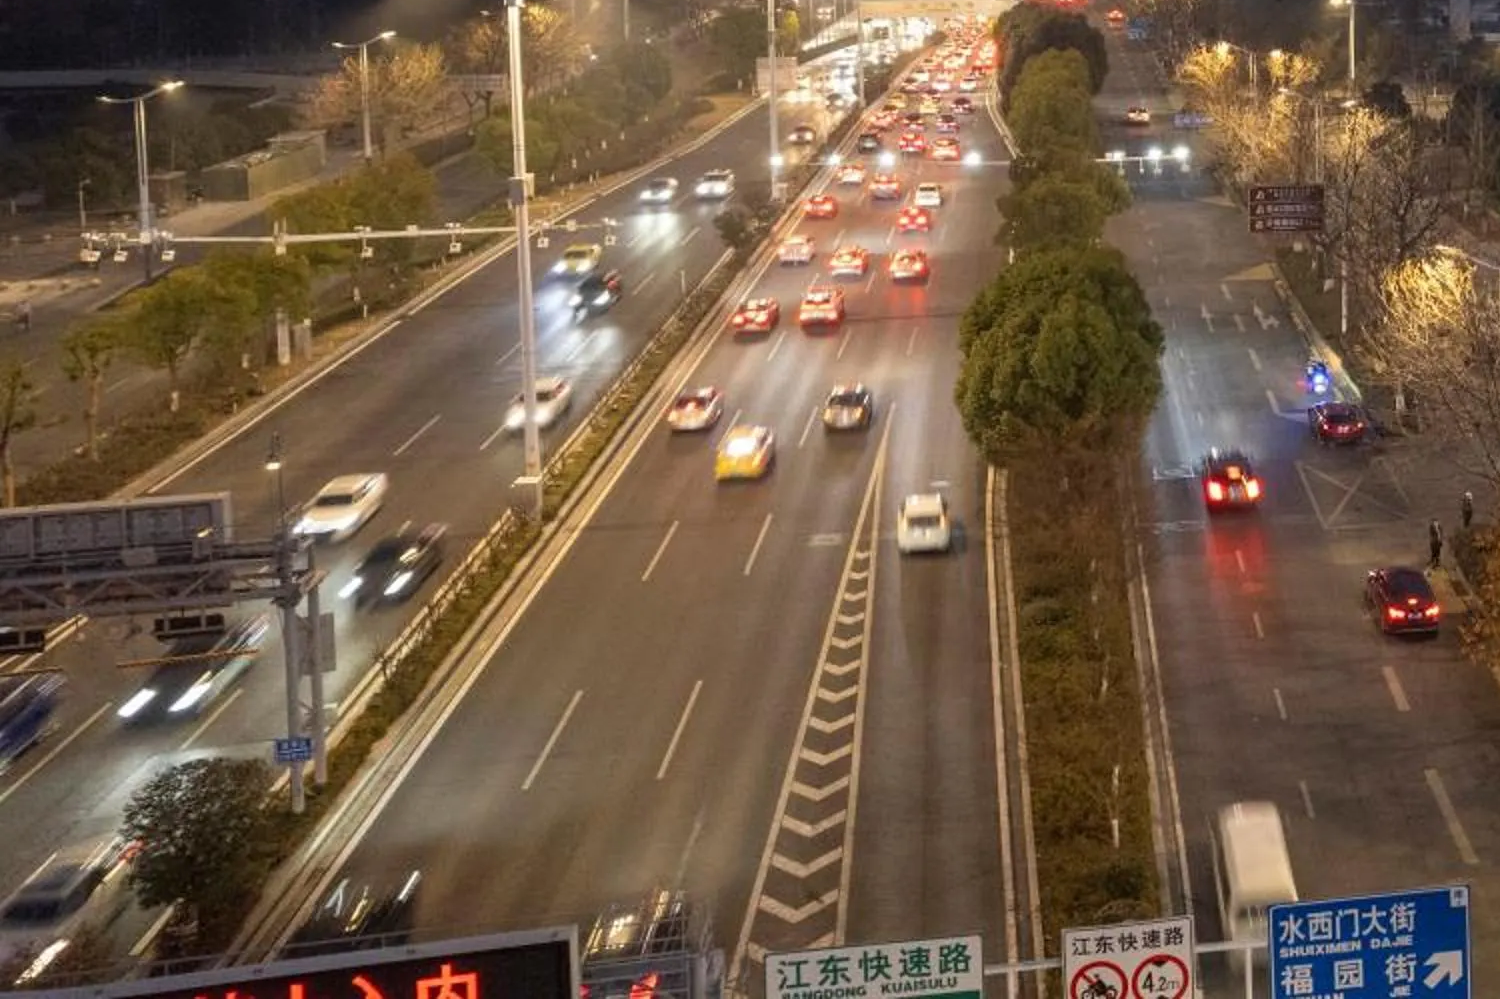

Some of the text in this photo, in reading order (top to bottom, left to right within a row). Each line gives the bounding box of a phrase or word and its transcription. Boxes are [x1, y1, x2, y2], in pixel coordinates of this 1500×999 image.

[1279, 902, 1417, 944] 水西门大街
[1072, 926, 1184, 956] 江东快速路
[1279, 935, 1413, 958] SHUIXIMEN DAJIE
[777, 943, 972, 991] 江东快速路
[881, 977, 958, 995] KUAISULU
